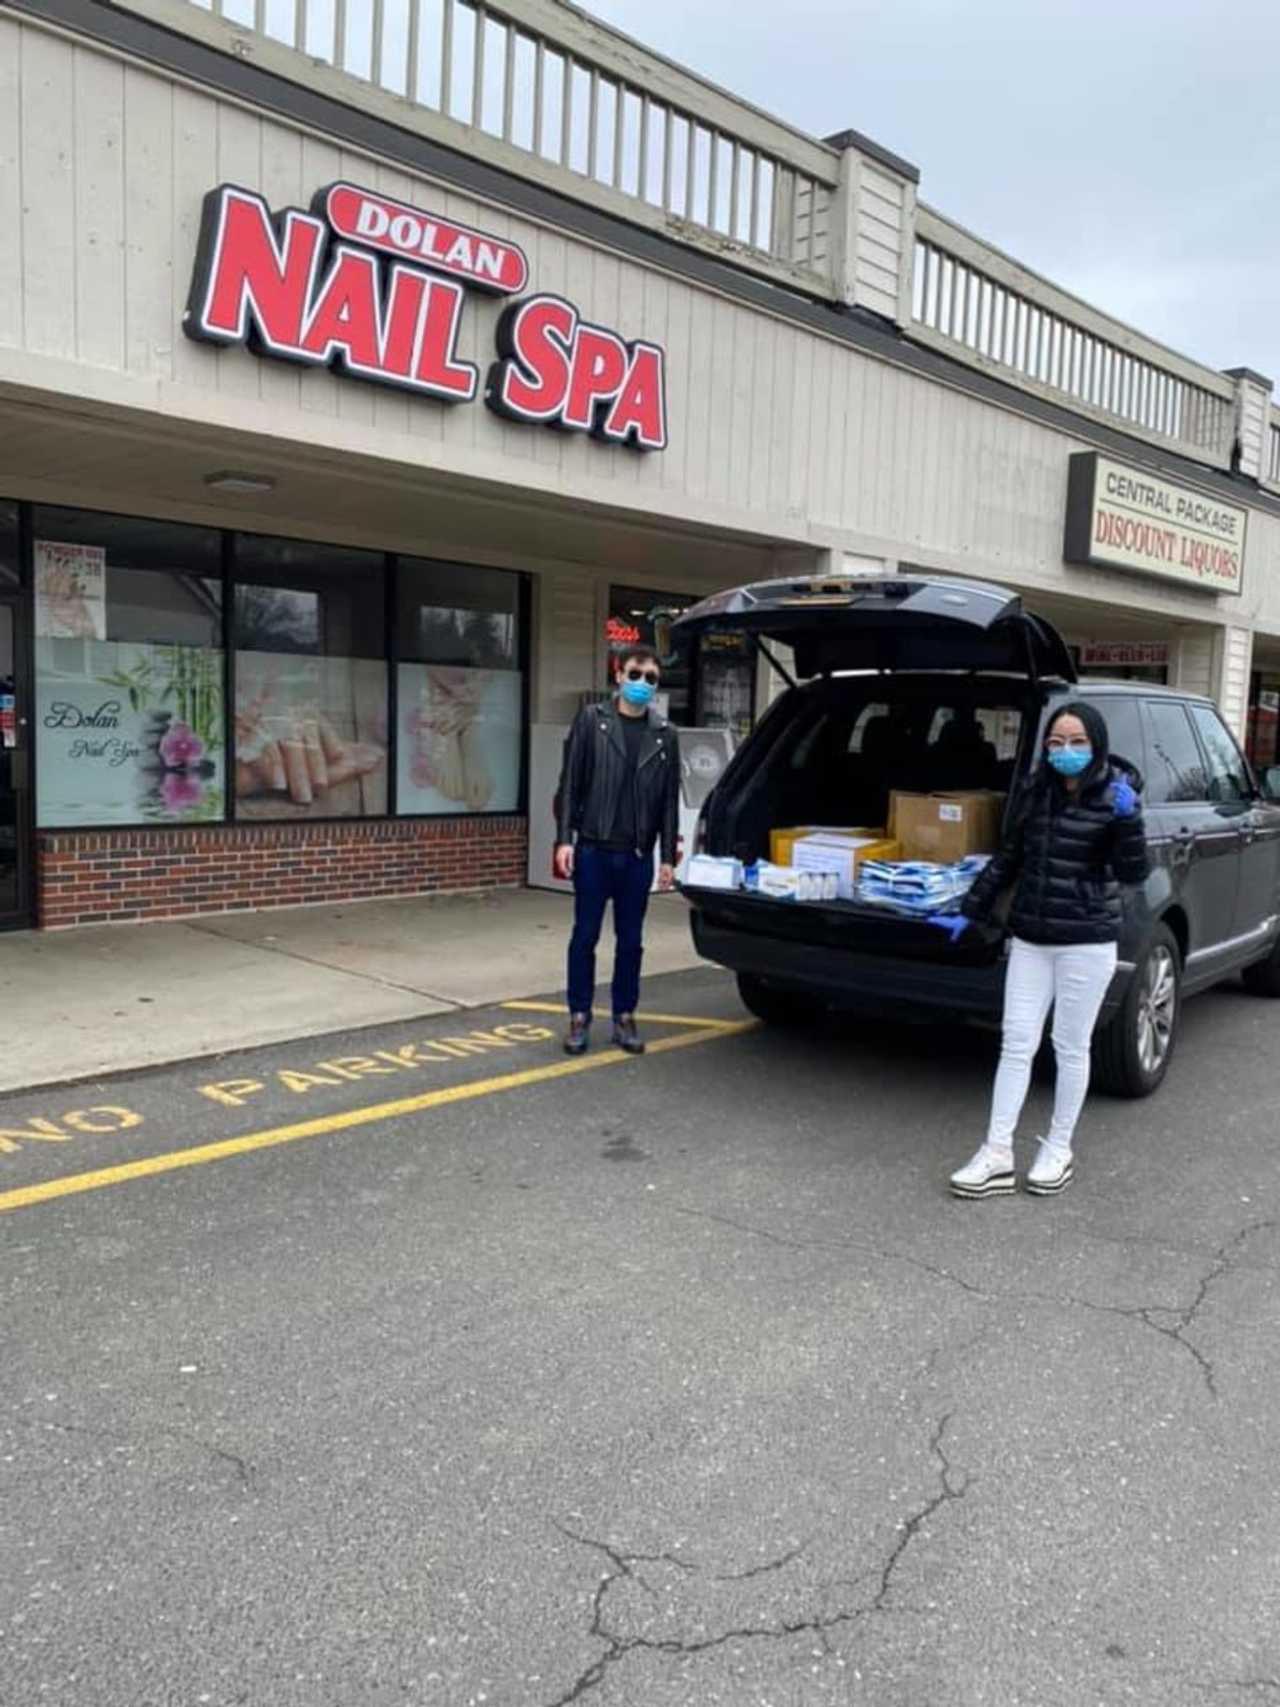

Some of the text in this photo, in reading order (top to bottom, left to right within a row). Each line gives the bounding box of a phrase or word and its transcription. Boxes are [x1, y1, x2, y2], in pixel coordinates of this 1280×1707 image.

[356, 200, 505, 279] DOLAN
[202, 187, 667, 448] NAIL SPA
[1106, 472, 1238, 535] CENTRAL PACKAGE
[1095, 509, 1239, 579] DISCOUNT LIQUORS
[43, 701, 121, 729] Dolan
[0, 1023, 554, 1152] NO PARKING
